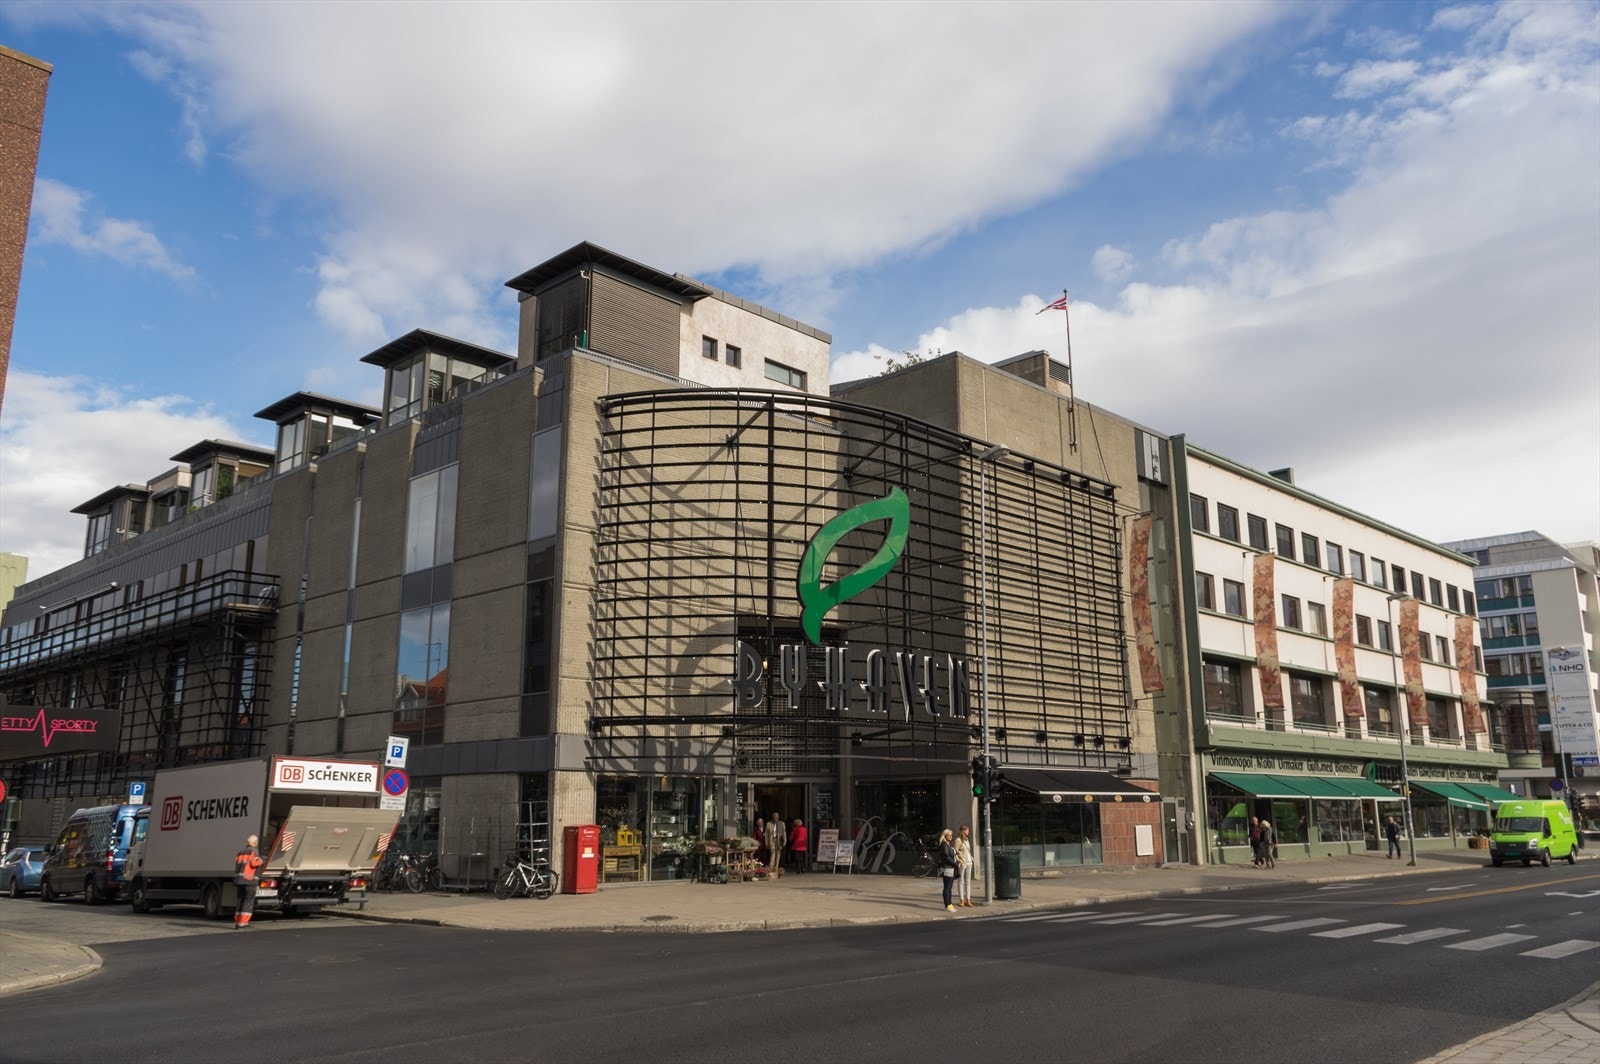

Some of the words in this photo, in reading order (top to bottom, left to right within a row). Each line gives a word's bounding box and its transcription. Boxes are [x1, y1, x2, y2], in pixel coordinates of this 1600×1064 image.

[1558, 663, 1584, 671] NHO
[2, 717, 35, 728] ETTY
[50, 719, 98, 730] SPORTY
[1210, 752, 1254, 771] Vinmonopol
[1278, 757, 1304, 771] Urmaker
[283, 767, 301, 781] DB
[308, 769, 372, 783] SCHENKER
[164, 802, 180, 826] DB
[186, 796, 249, 821] SCHENKER
